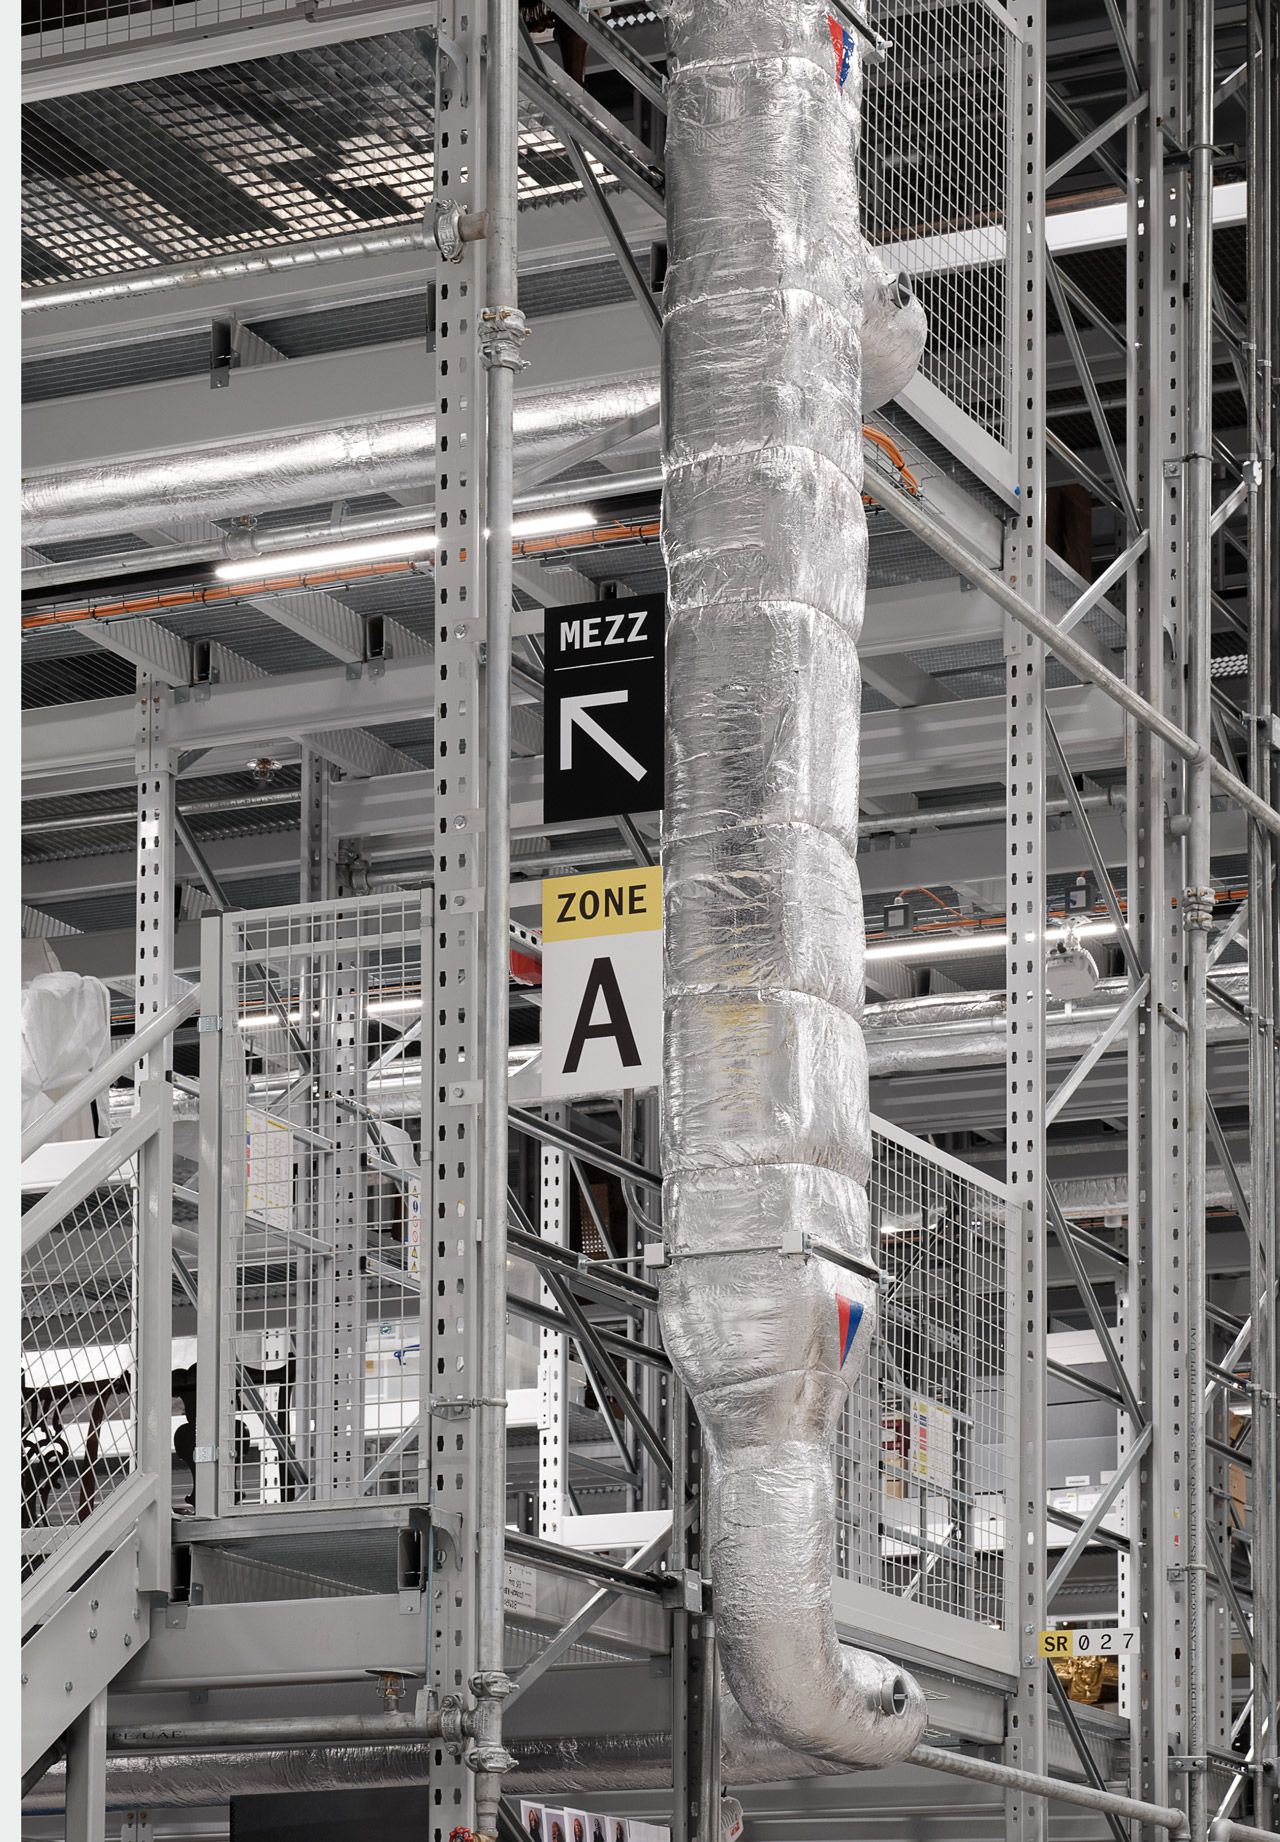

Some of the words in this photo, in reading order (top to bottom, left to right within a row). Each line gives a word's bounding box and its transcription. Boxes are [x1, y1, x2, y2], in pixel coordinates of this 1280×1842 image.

[559, 610, 649, 652] MEZZ
[556, 884, 648, 923] ZONE
[562, 956, 643, 1074] A
[1044, 1636, 1068, 1652] SR
